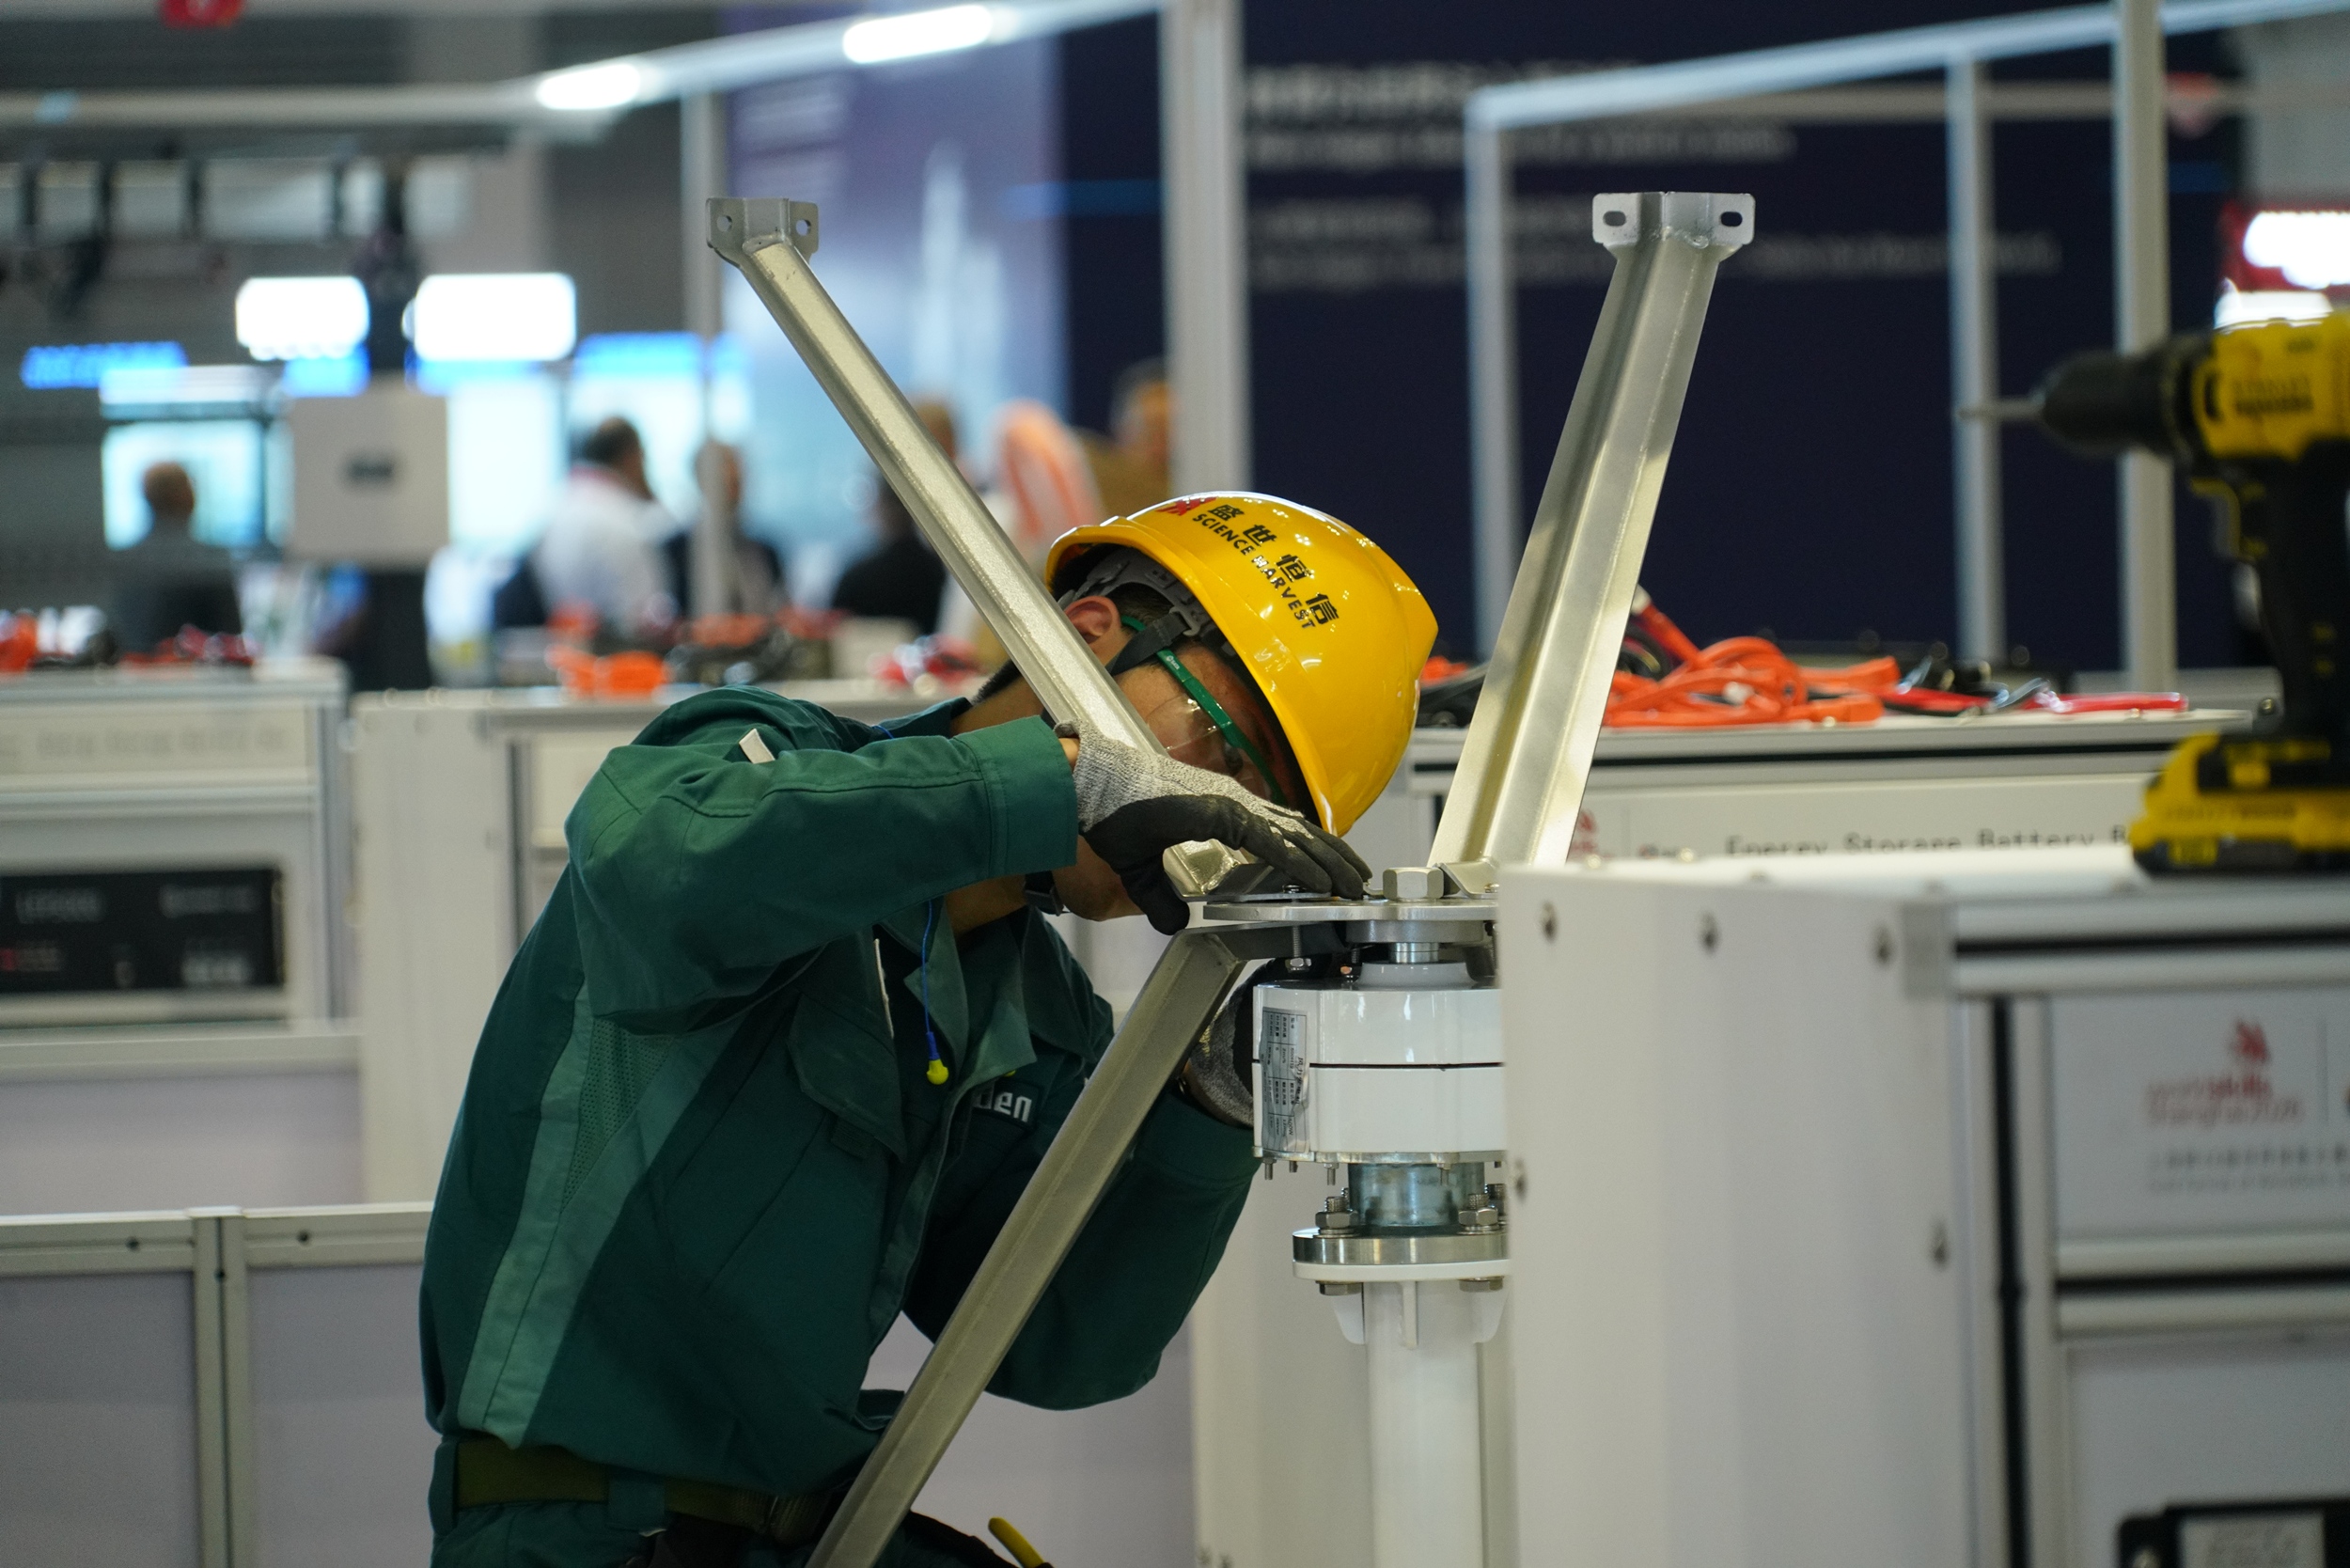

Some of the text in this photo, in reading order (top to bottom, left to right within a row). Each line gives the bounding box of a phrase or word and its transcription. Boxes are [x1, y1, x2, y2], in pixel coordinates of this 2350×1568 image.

[1192, 513, 1315, 629] SCIENCE HARVEST
[1208, 504, 1340, 625] 盛世恒信
